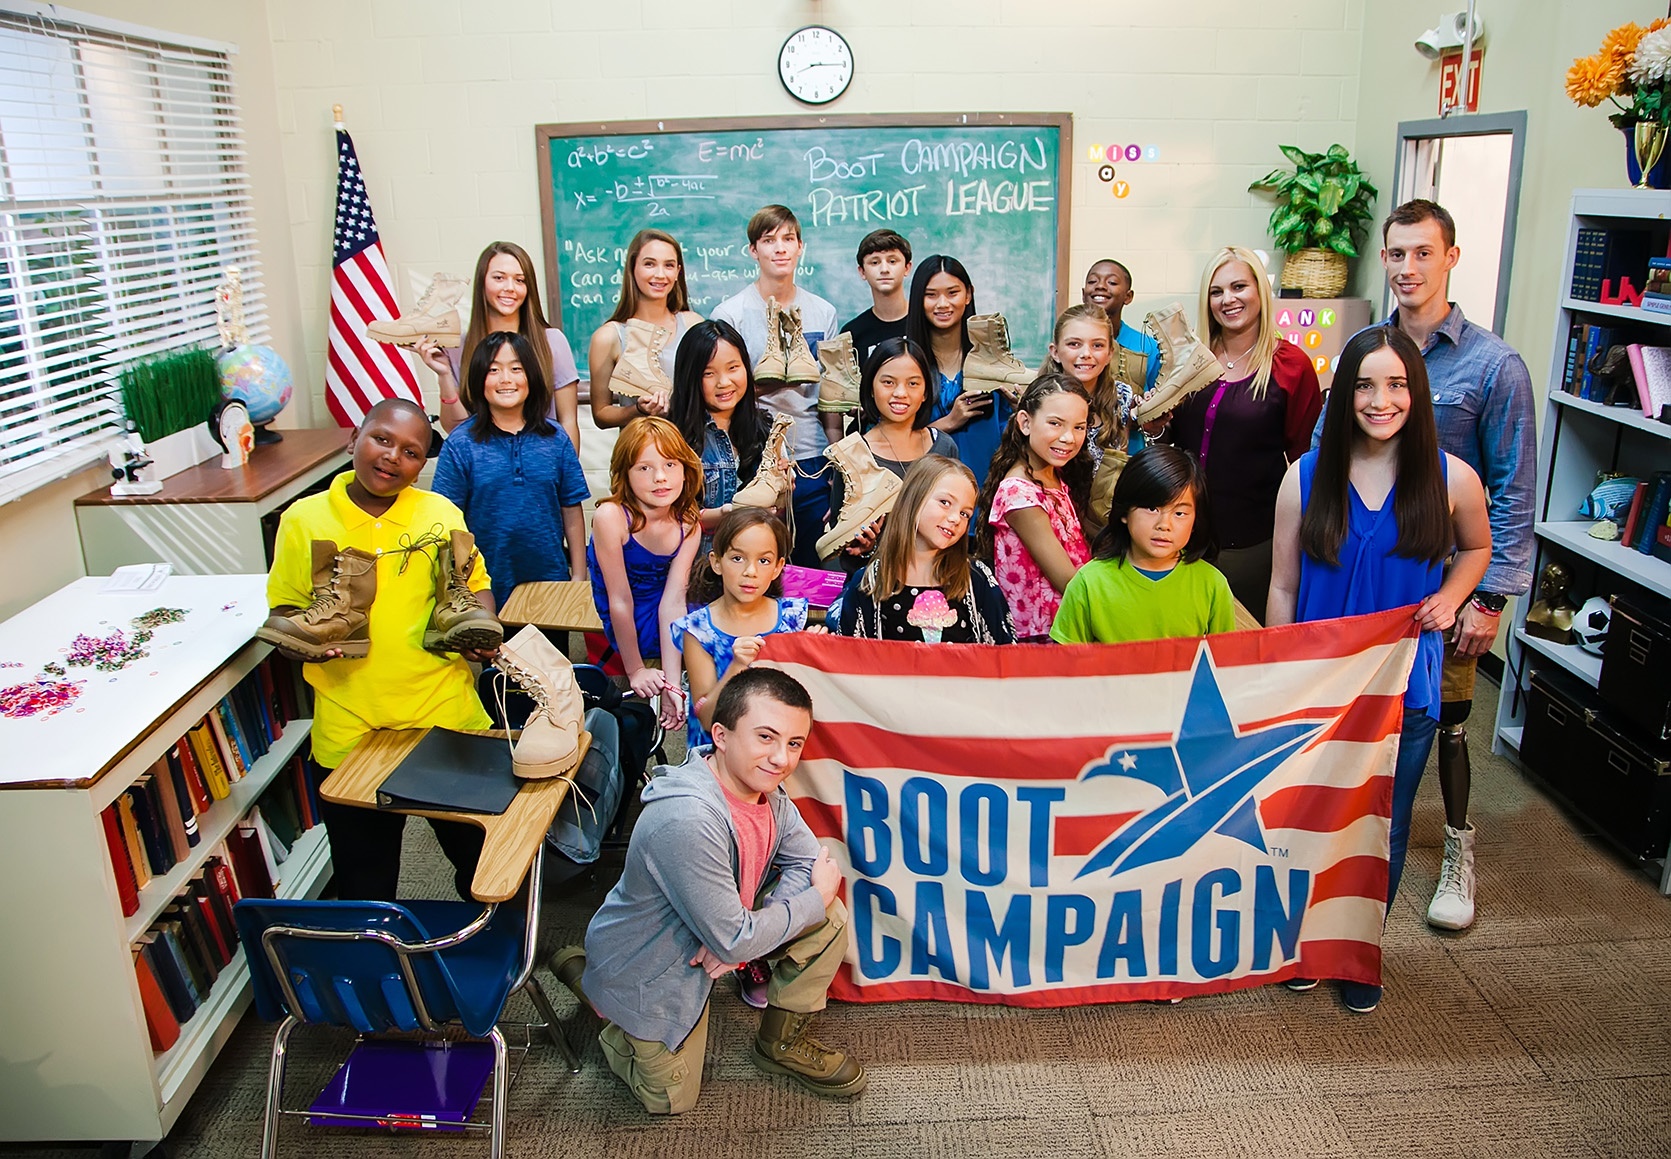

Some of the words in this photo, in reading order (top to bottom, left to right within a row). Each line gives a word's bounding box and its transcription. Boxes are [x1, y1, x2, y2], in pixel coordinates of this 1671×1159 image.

[1442, 60, 1480, 105] EXT
[901, 137, 1048, 177] CAMPAIGN
[808, 185, 926, 227] PATRIOT
[946, 179, 1054, 216] LEAGUE
[697, 244, 734, 271] your
[744, 264, 760, 279] wh
[843, 769, 1066, 888] BOOT
[1271, 847, 1289, 858] TM
[852, 865, 1310, 990] CAMPAIGN
